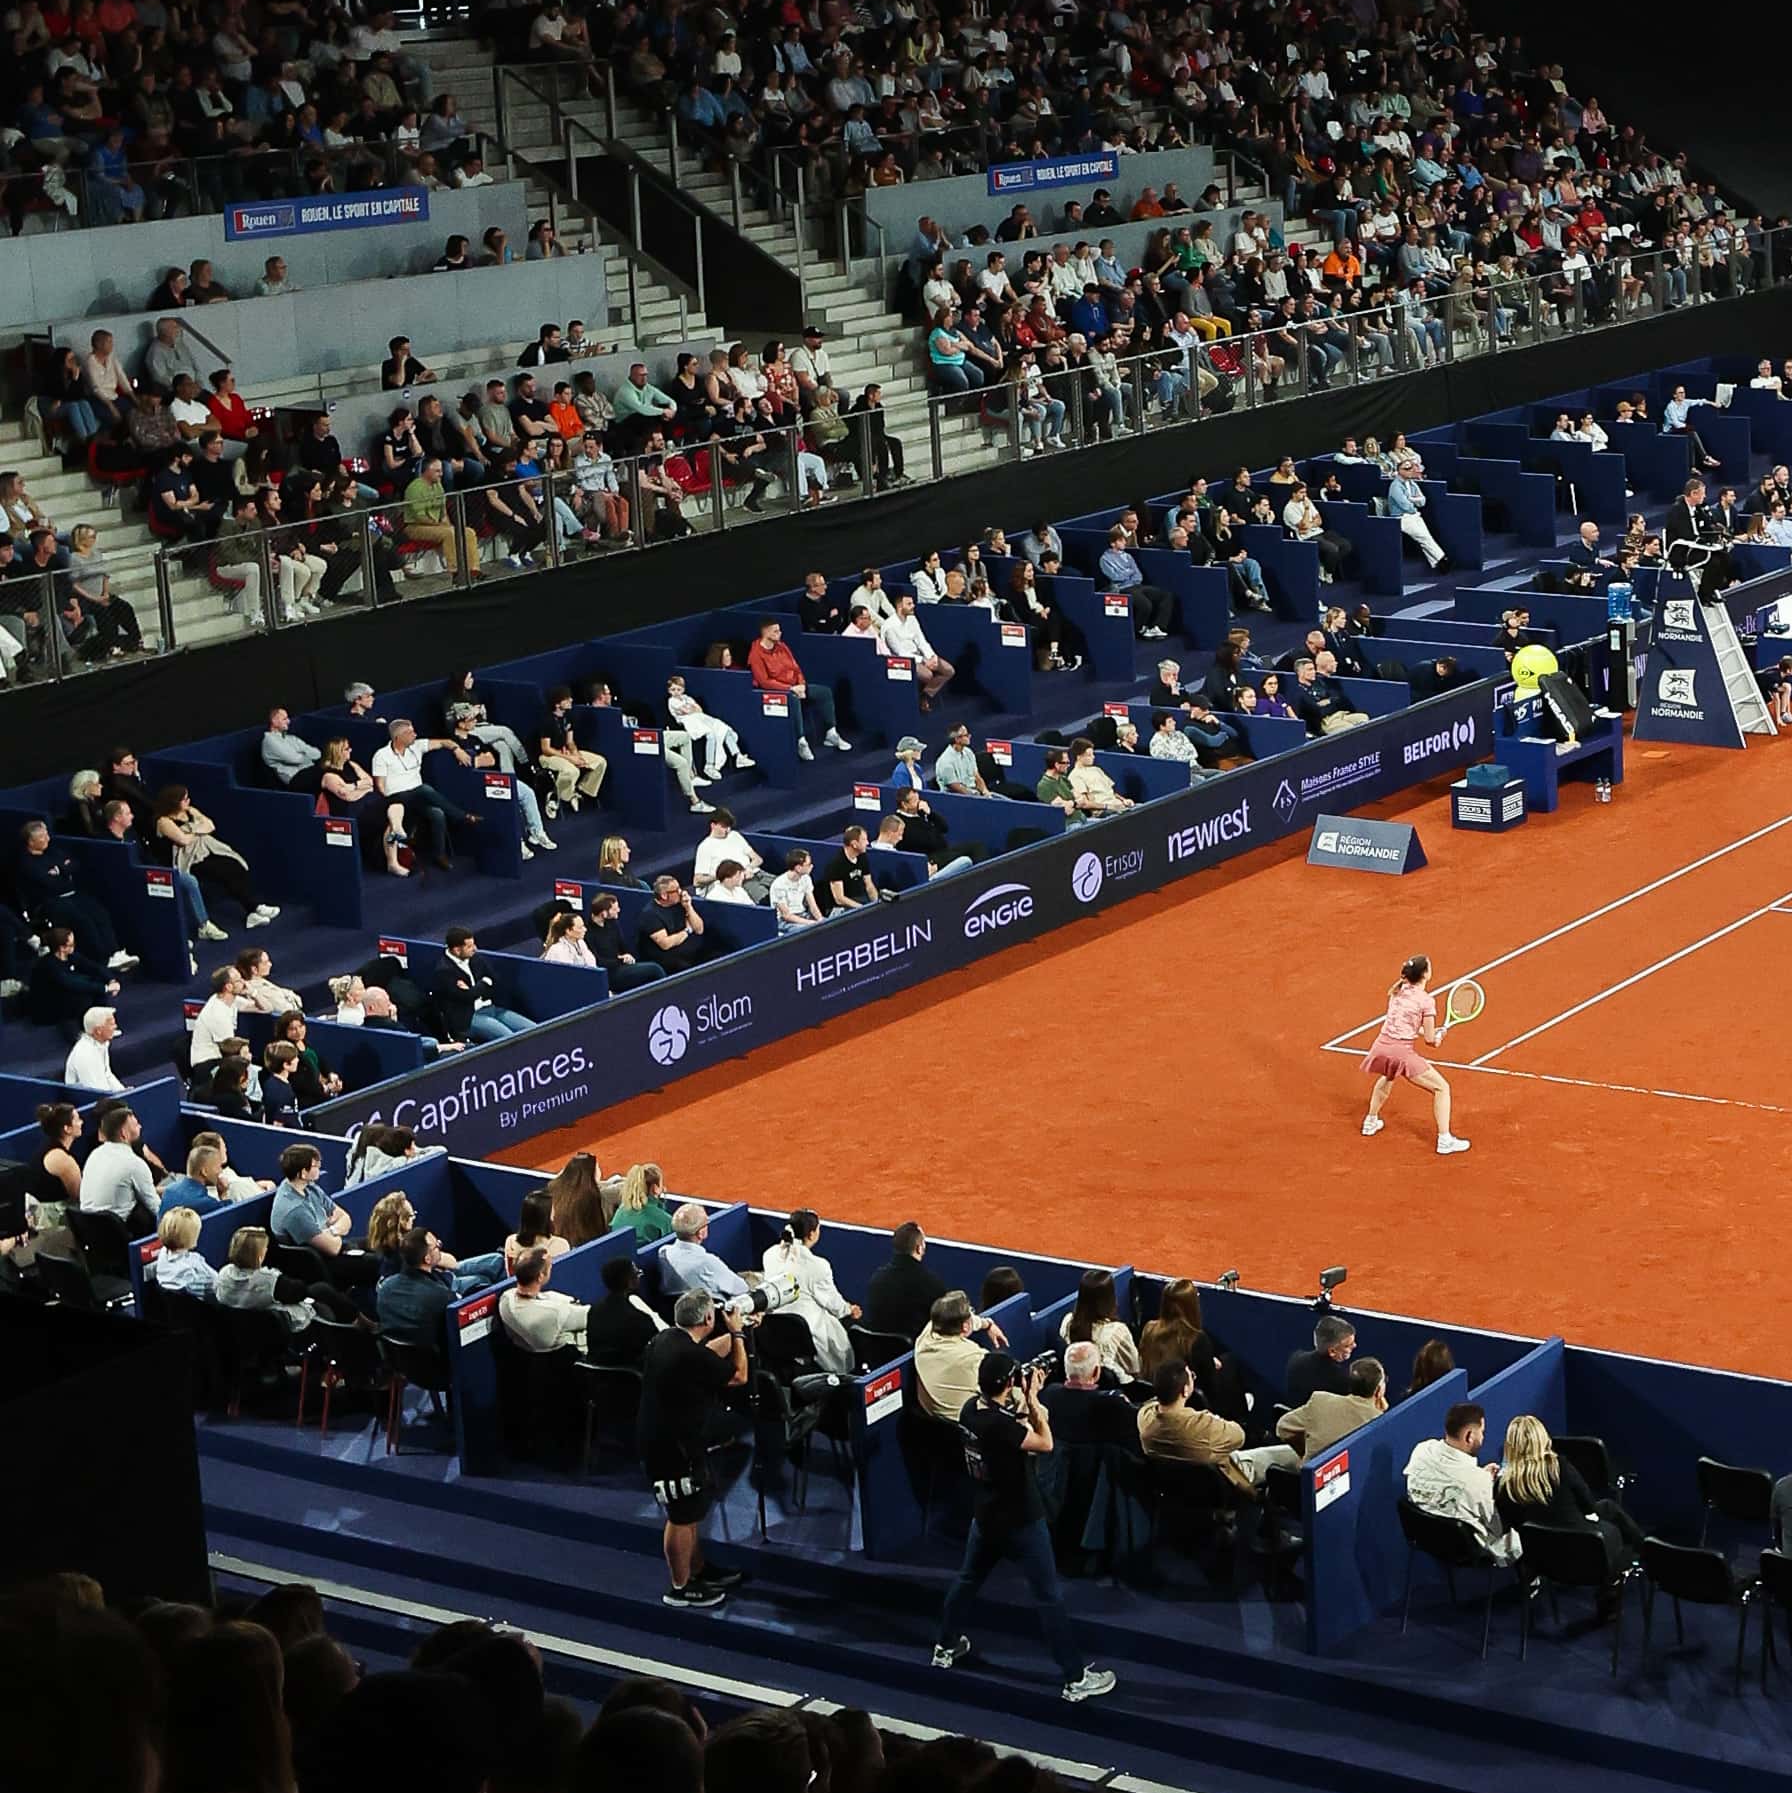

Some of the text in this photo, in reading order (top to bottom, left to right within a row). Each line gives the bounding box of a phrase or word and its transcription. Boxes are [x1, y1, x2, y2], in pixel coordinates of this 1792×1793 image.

[301, 197, 420, 224] ROUEN, LE SPORT EN CAPITALE
[1658, 631, 1704, 643] NORMANDIE
[1651, 707, 1705, 721] NORMANDIE
[1404, 731, 1450, 764] BELFOR
[1301, 773, 1332, 791] Maisons
[1333, 763, 1357, 780] France
[1358, 751, 1381, 769] STYLE
[1338, 843, 1400, 860] NORMANDIE
[1340, 834, 1372, 846] RÉGION
[796, 919, 932, 992] HERBELIN
[393, 1047, 594, 1135] Capfinances.
[500, 1083, 588, 1129] By Premium
